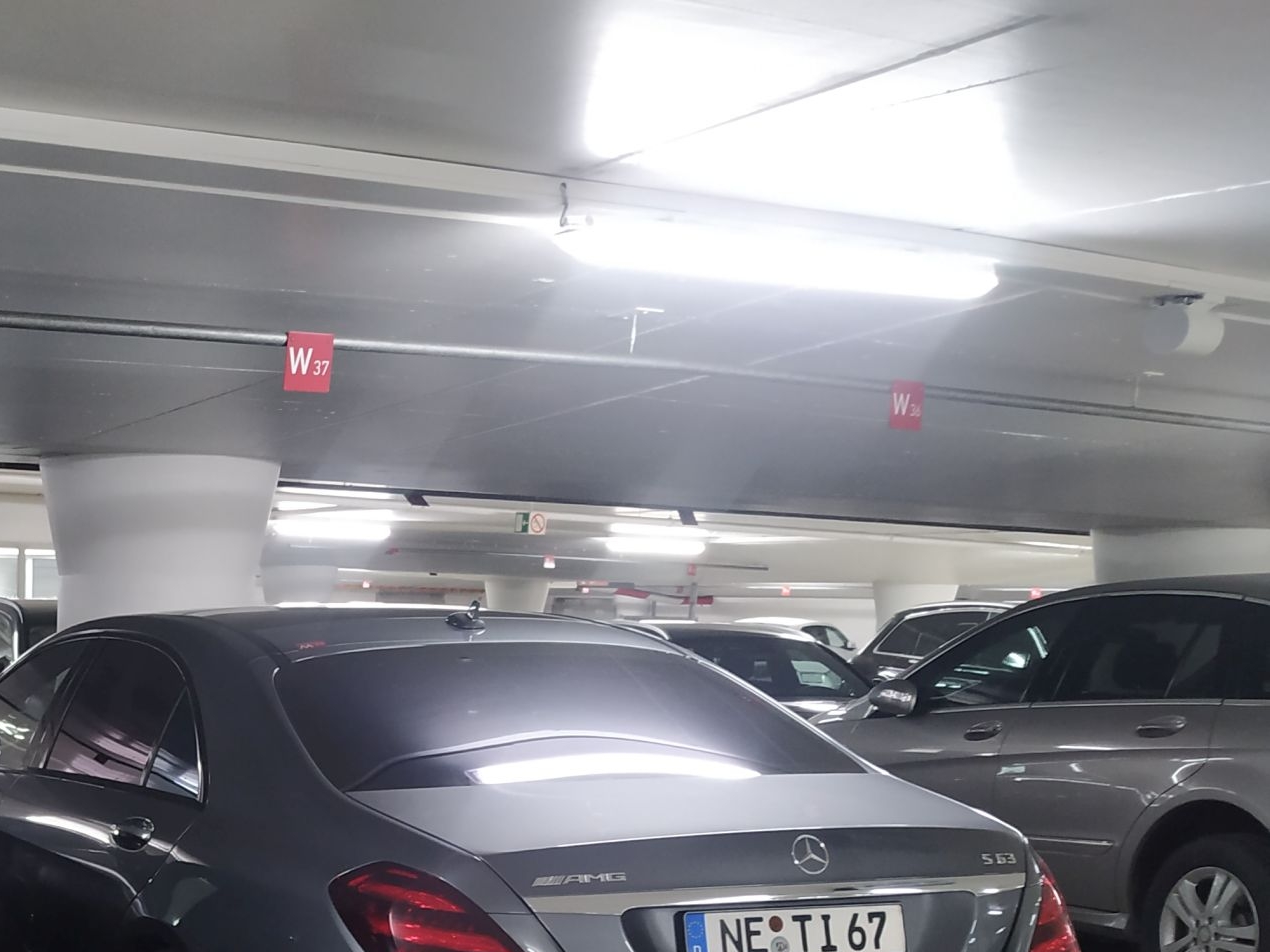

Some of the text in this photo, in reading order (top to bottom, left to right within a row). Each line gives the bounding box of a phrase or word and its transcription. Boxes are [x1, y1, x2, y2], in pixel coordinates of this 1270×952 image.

[289, 346, 330, 376] W 37
[893, 392, 910, 415] W
[981, 852, 1017, 865] S 63
[562, 872, 627, 884] AMG
[791, 914, 837, 952] TI
[847, 911, 887, 951] 67
